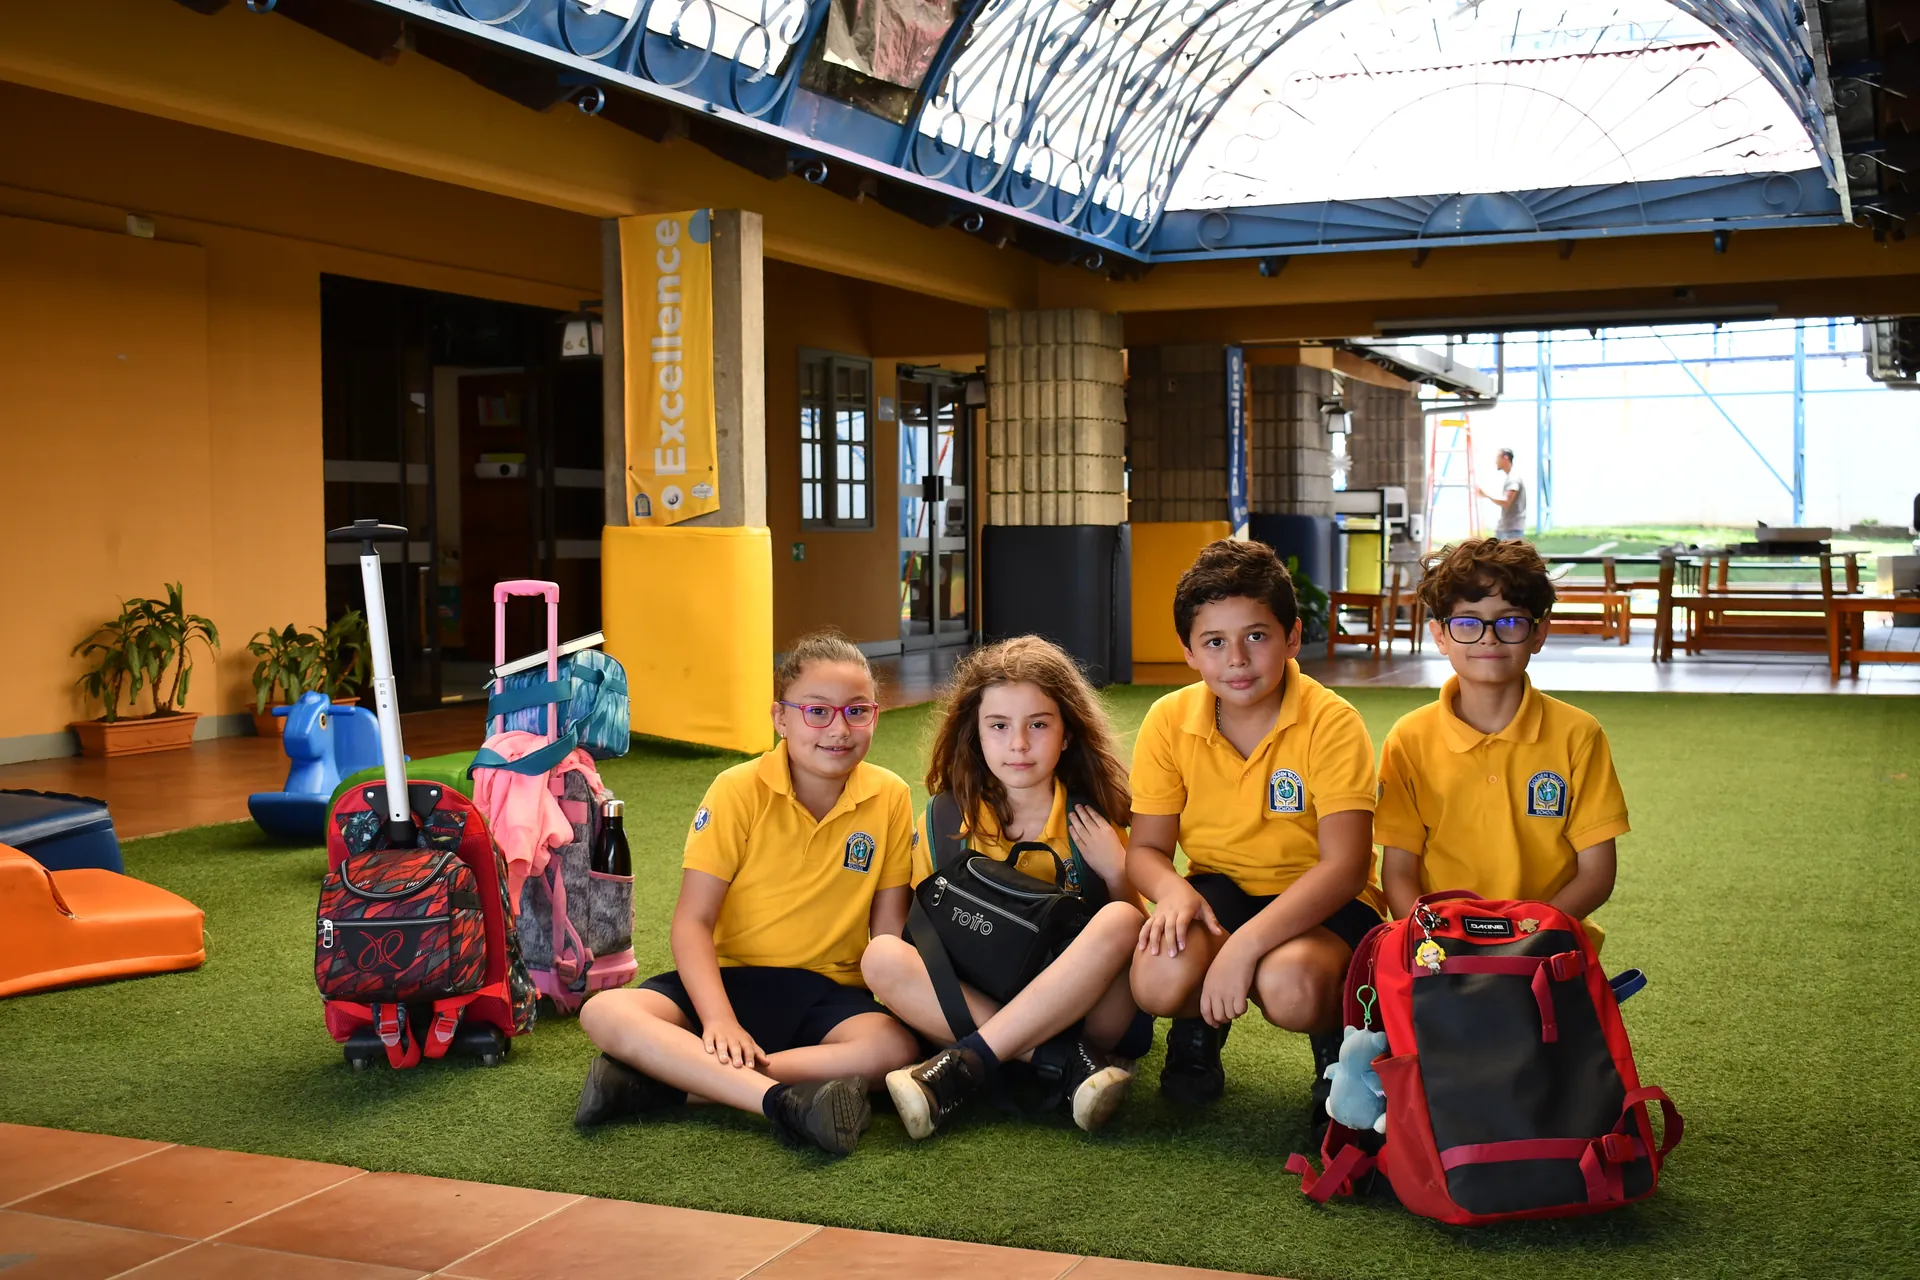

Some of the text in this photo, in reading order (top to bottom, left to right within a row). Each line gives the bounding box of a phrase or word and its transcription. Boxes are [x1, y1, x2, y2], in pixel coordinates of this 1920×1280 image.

[651, 219, 686, 475] Excellence
[1231, 356, 1240, 497] Discipline
[1270, 771, 1302, 787] GOLDEN VALLEY
[1530, 773, 1565, 788] GOLDEN VALLEY
